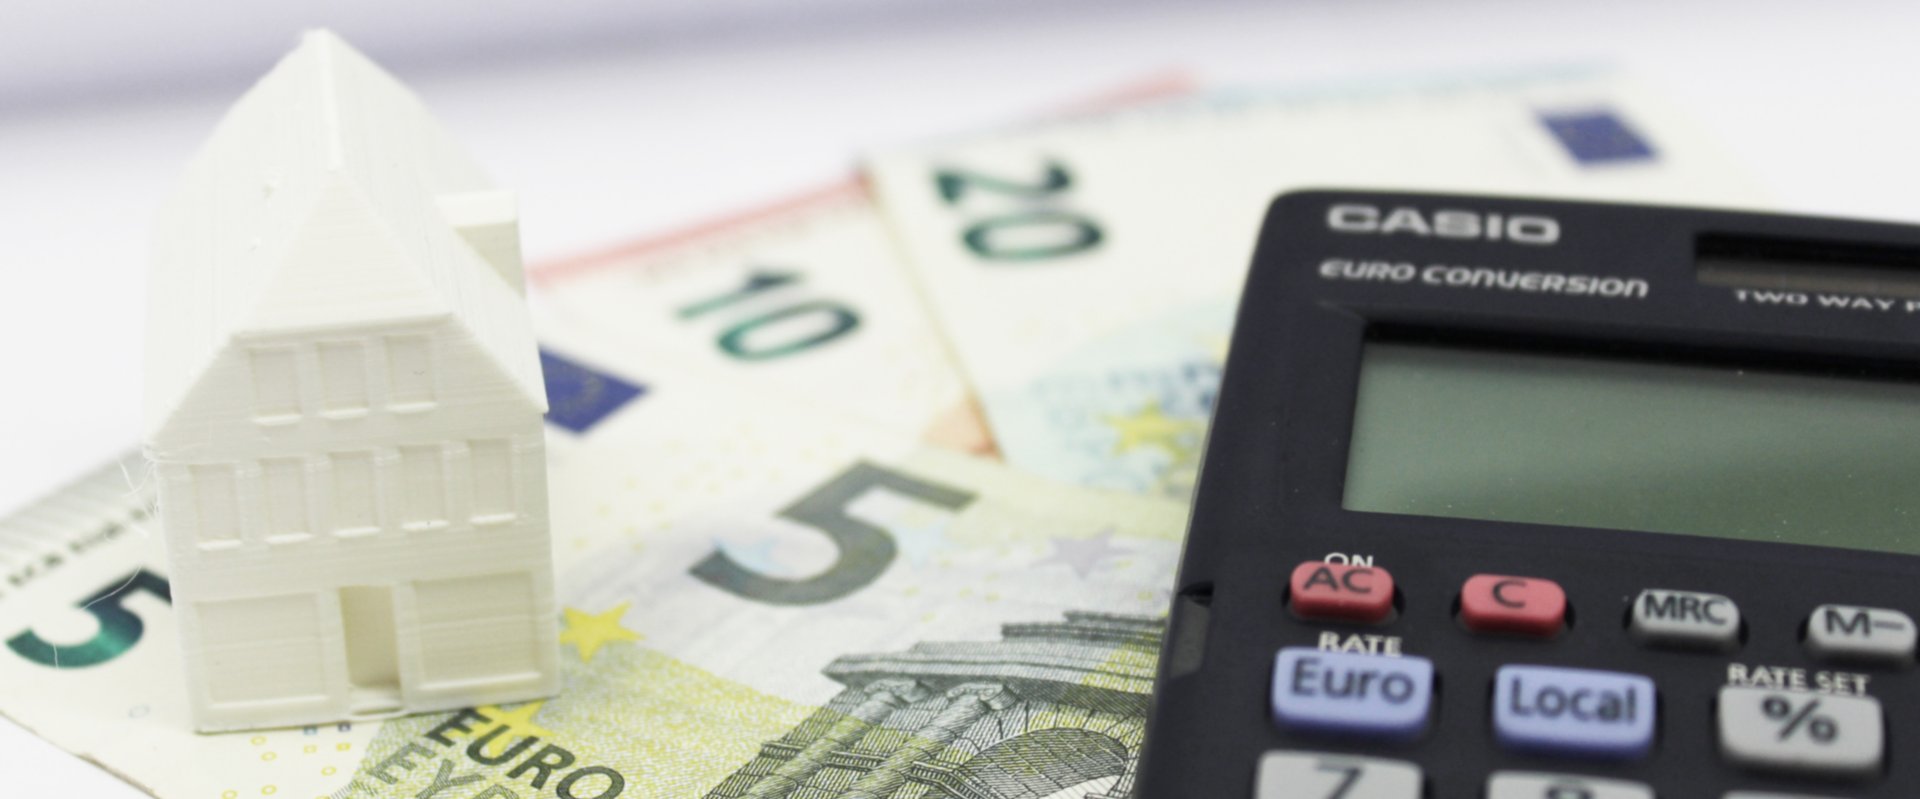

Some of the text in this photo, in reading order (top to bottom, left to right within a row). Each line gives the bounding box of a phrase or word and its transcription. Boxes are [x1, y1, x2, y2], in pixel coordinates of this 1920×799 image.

[931, 156, 1106, 262] 20
[1327, 204, 1561, 243] CASIO
[1318, 258, 1416, 283] EURO
[673, 269, 863, 362] 10
[1735, 289, 1809, 304] TWO
[1816, 294, 1896, 311] WAY
[687, 457, 983, 606] 5
[1303, 566, 1375, 593] AC
[1492, 579, 1527, 608] C
[5, 567, 173, 669] 5
[1643, 594, 1728, 626] MRC
[1317, 630, 1402, 657] RATE
[1290, 658, 1416, 703] Euro
[1727, 662, 1871, 696] RATE SET
[1509, 678, 1637, 724] Local
[1760, 695, 1839, 744] %
[423, 707, 626, 799] EURO
